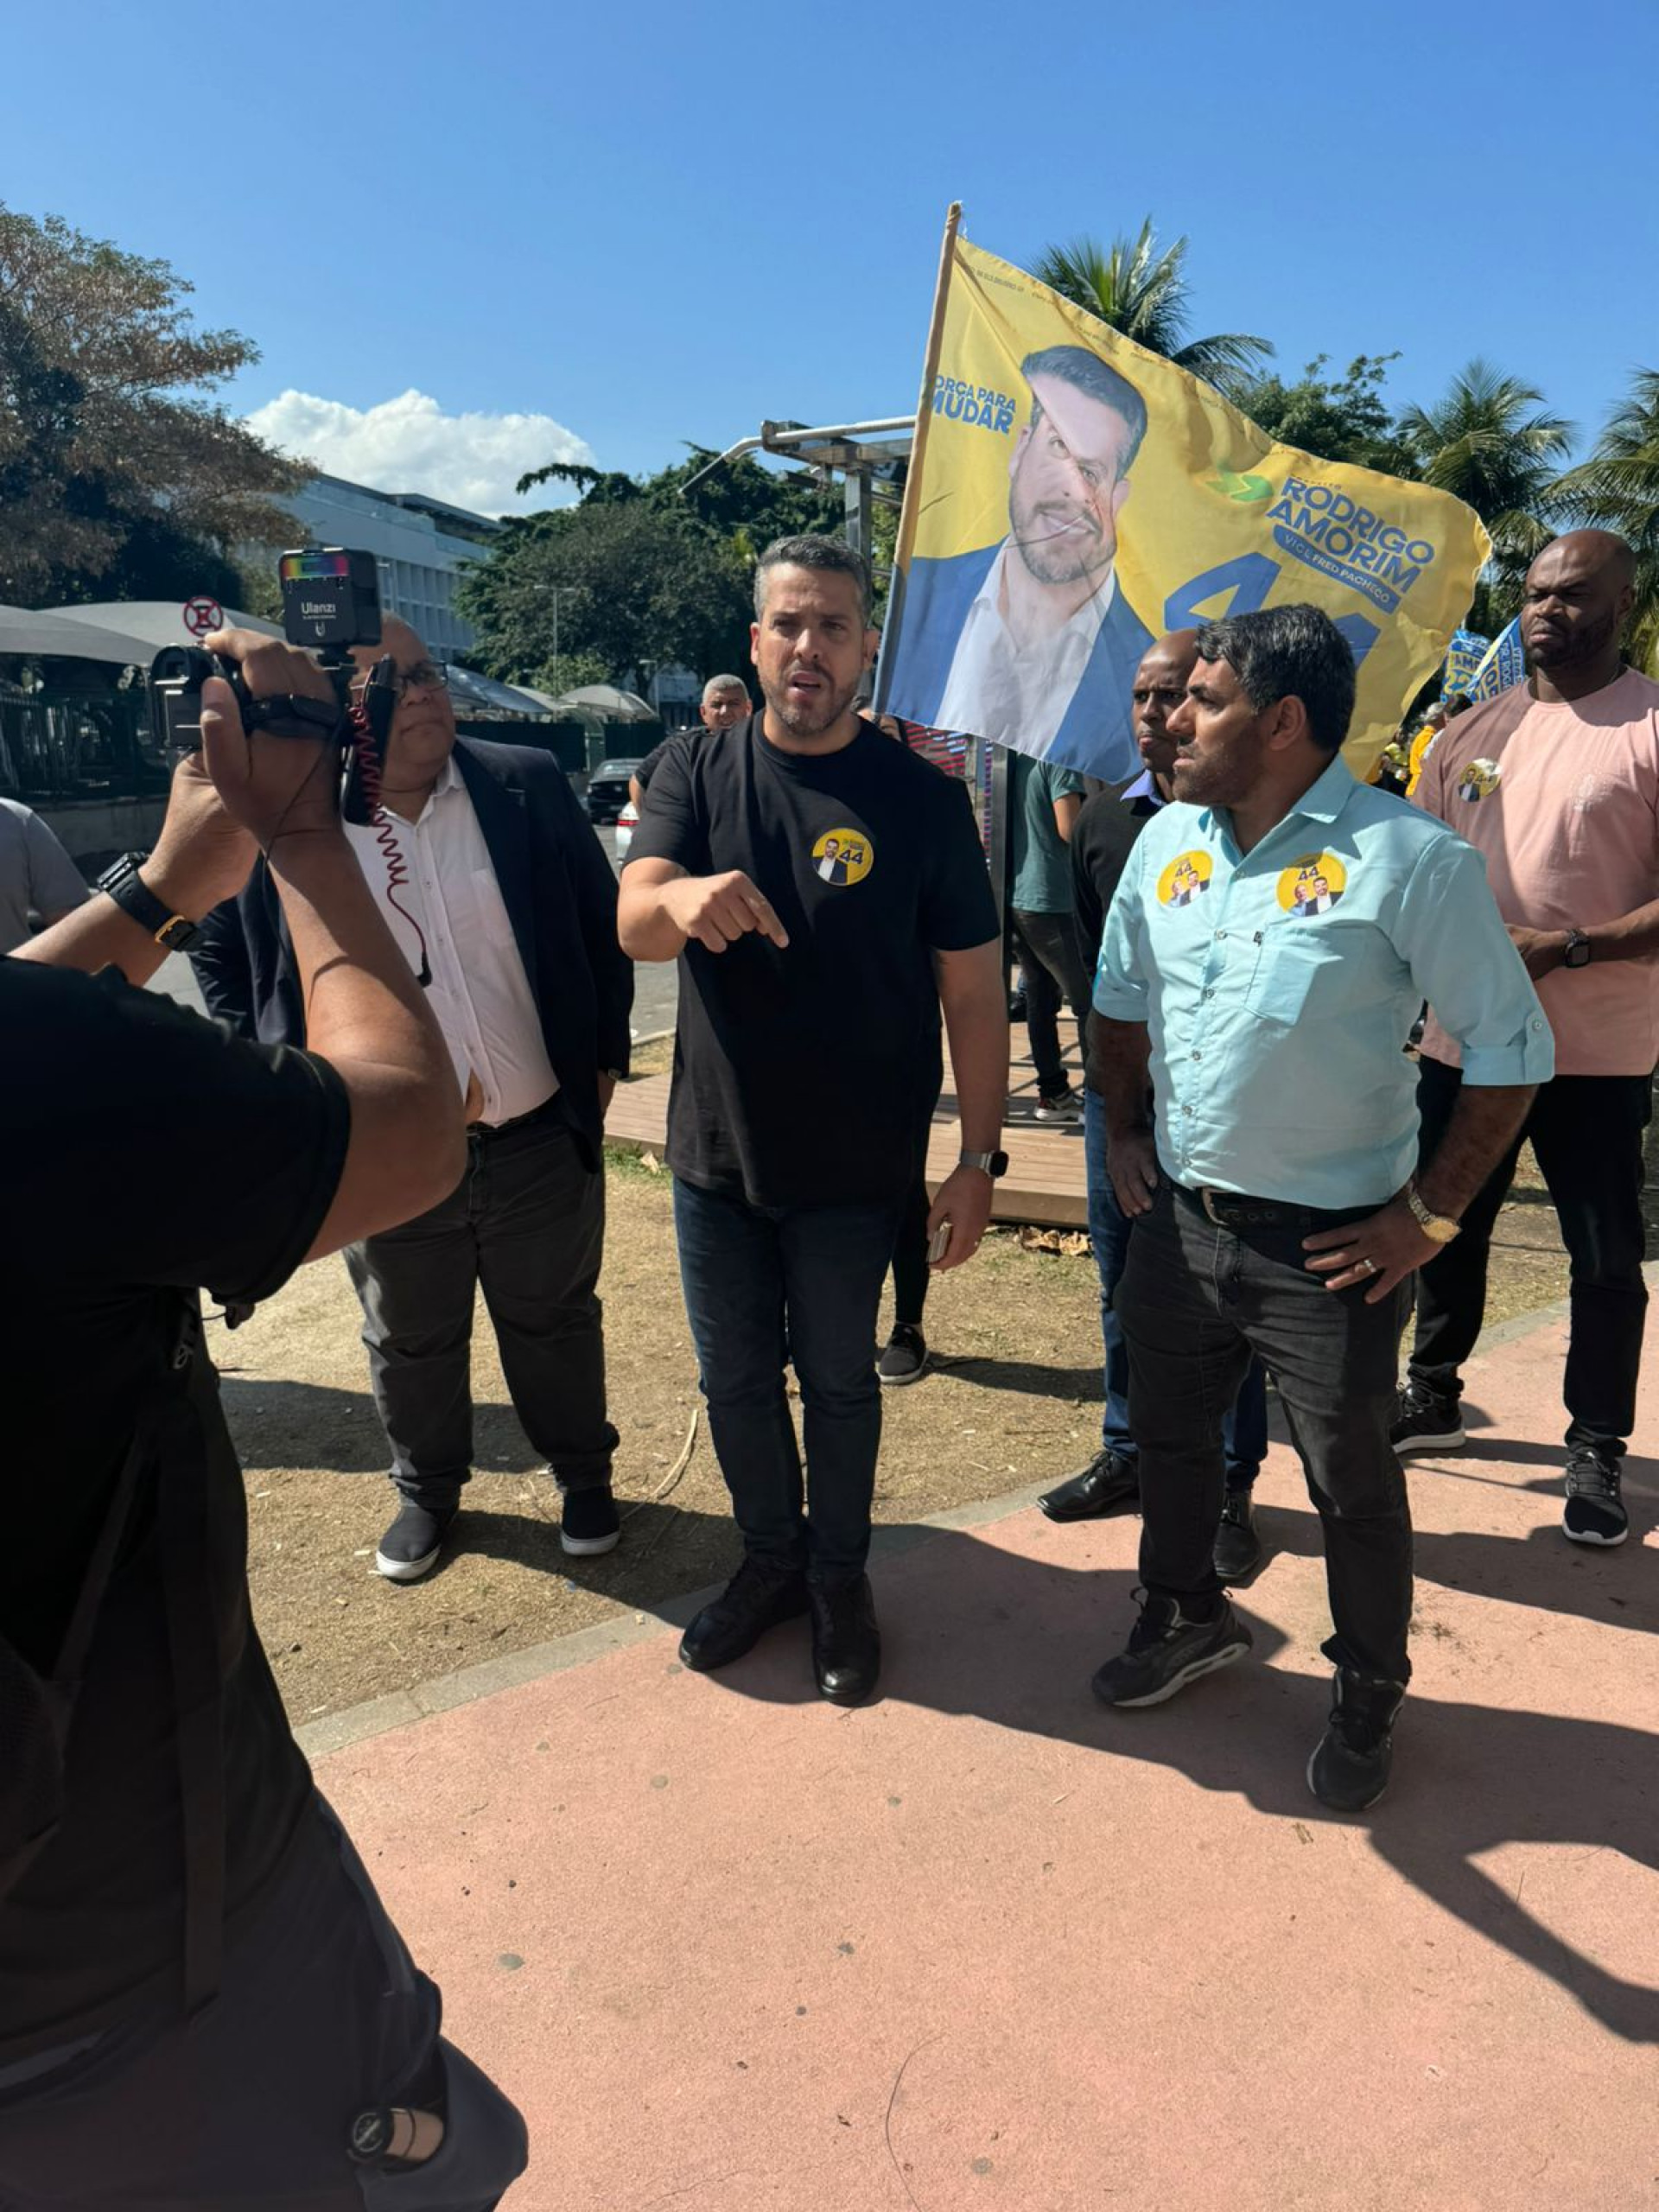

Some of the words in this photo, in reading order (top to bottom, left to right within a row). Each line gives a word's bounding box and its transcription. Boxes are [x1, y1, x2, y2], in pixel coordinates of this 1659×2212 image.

[934, 374, 975, 399] ORÇA
[977, 386, 1016, 413] PARA
[1281, 476, 1435, 565] RODRIGO
[1265, 499, 1422, 594] AMORIM
[1313, 553, 1339, 574] FRED
[1340, 569, 1390, 603] PACHECO
[302, 601, 336, 614] Ulanzi
[839, 849, 863, 865] 44
[1175, 862, 1192, 877] 44
[1298, 866, 1319, 880] 44
